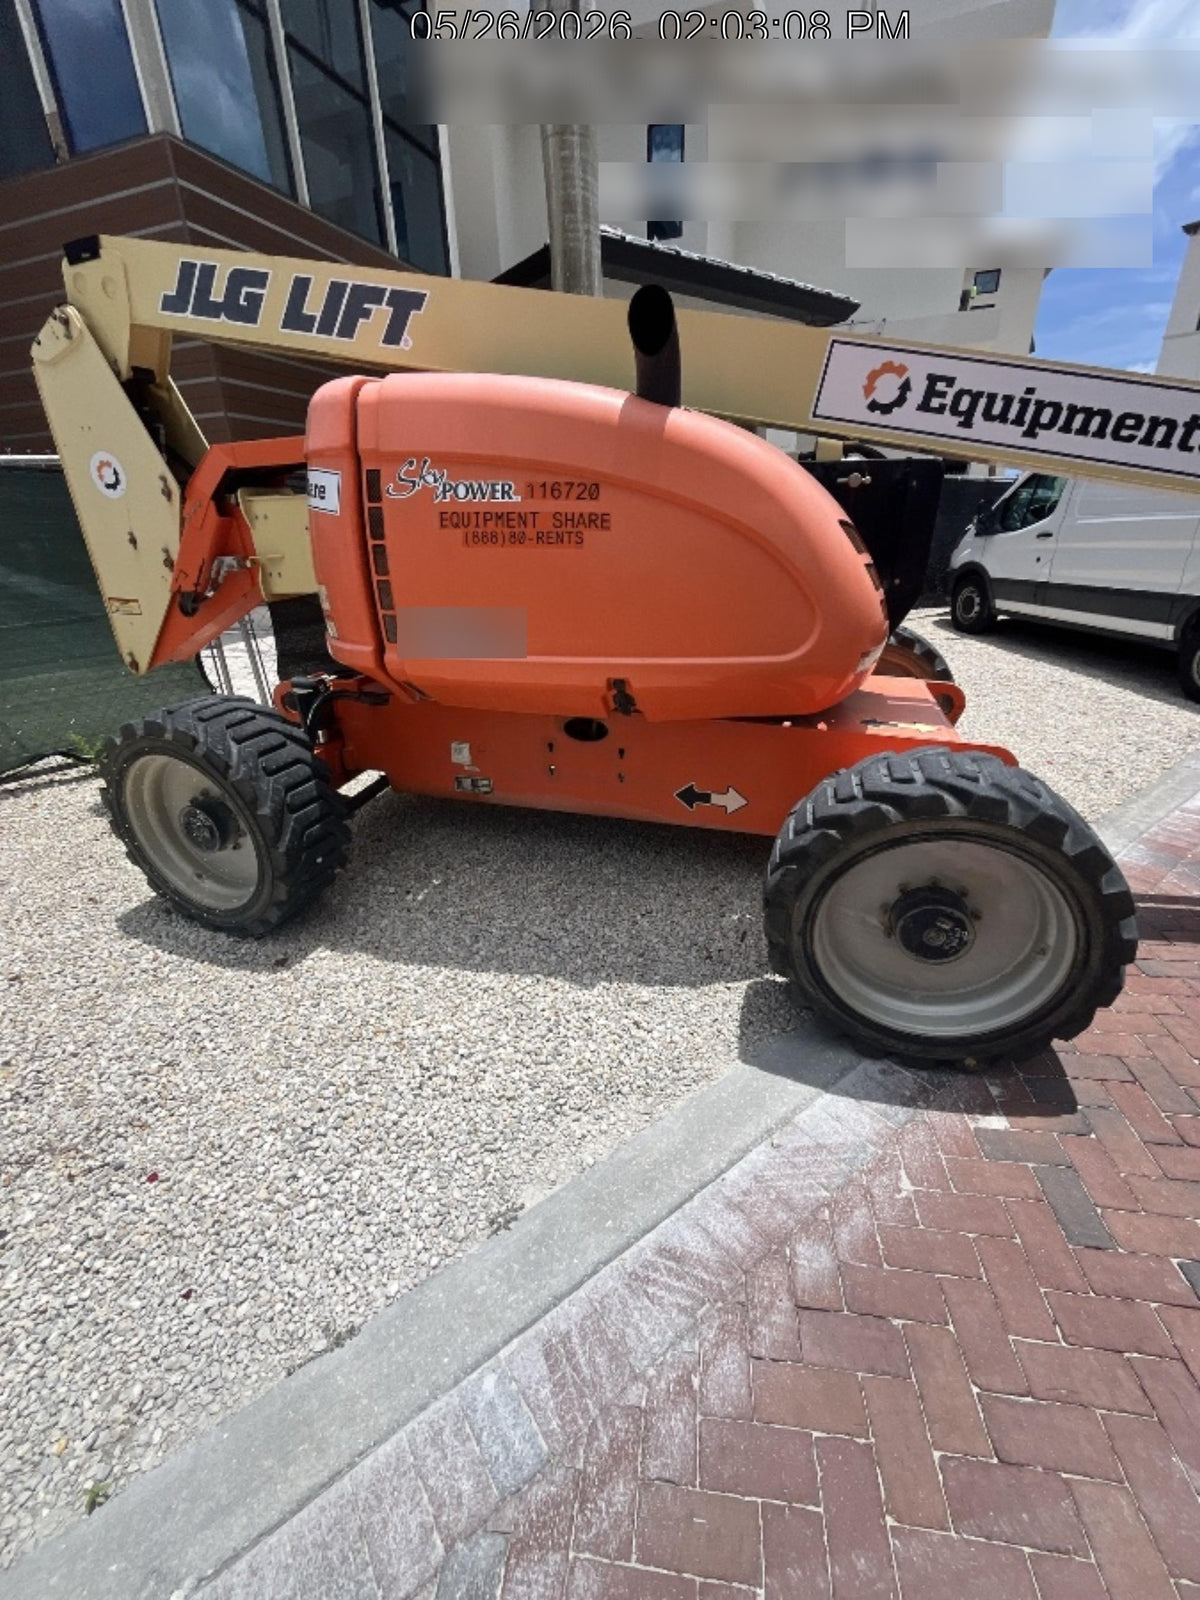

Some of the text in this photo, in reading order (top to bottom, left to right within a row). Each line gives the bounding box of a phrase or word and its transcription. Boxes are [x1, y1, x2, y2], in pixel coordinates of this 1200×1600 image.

[159, 258, 430, 347] JLG LIFT
[915, 373, 1200, 452] Equipment
[527, 481, 600, 501] 116720
[439, 511, 611, 531] EQUIPMENT SHARE
